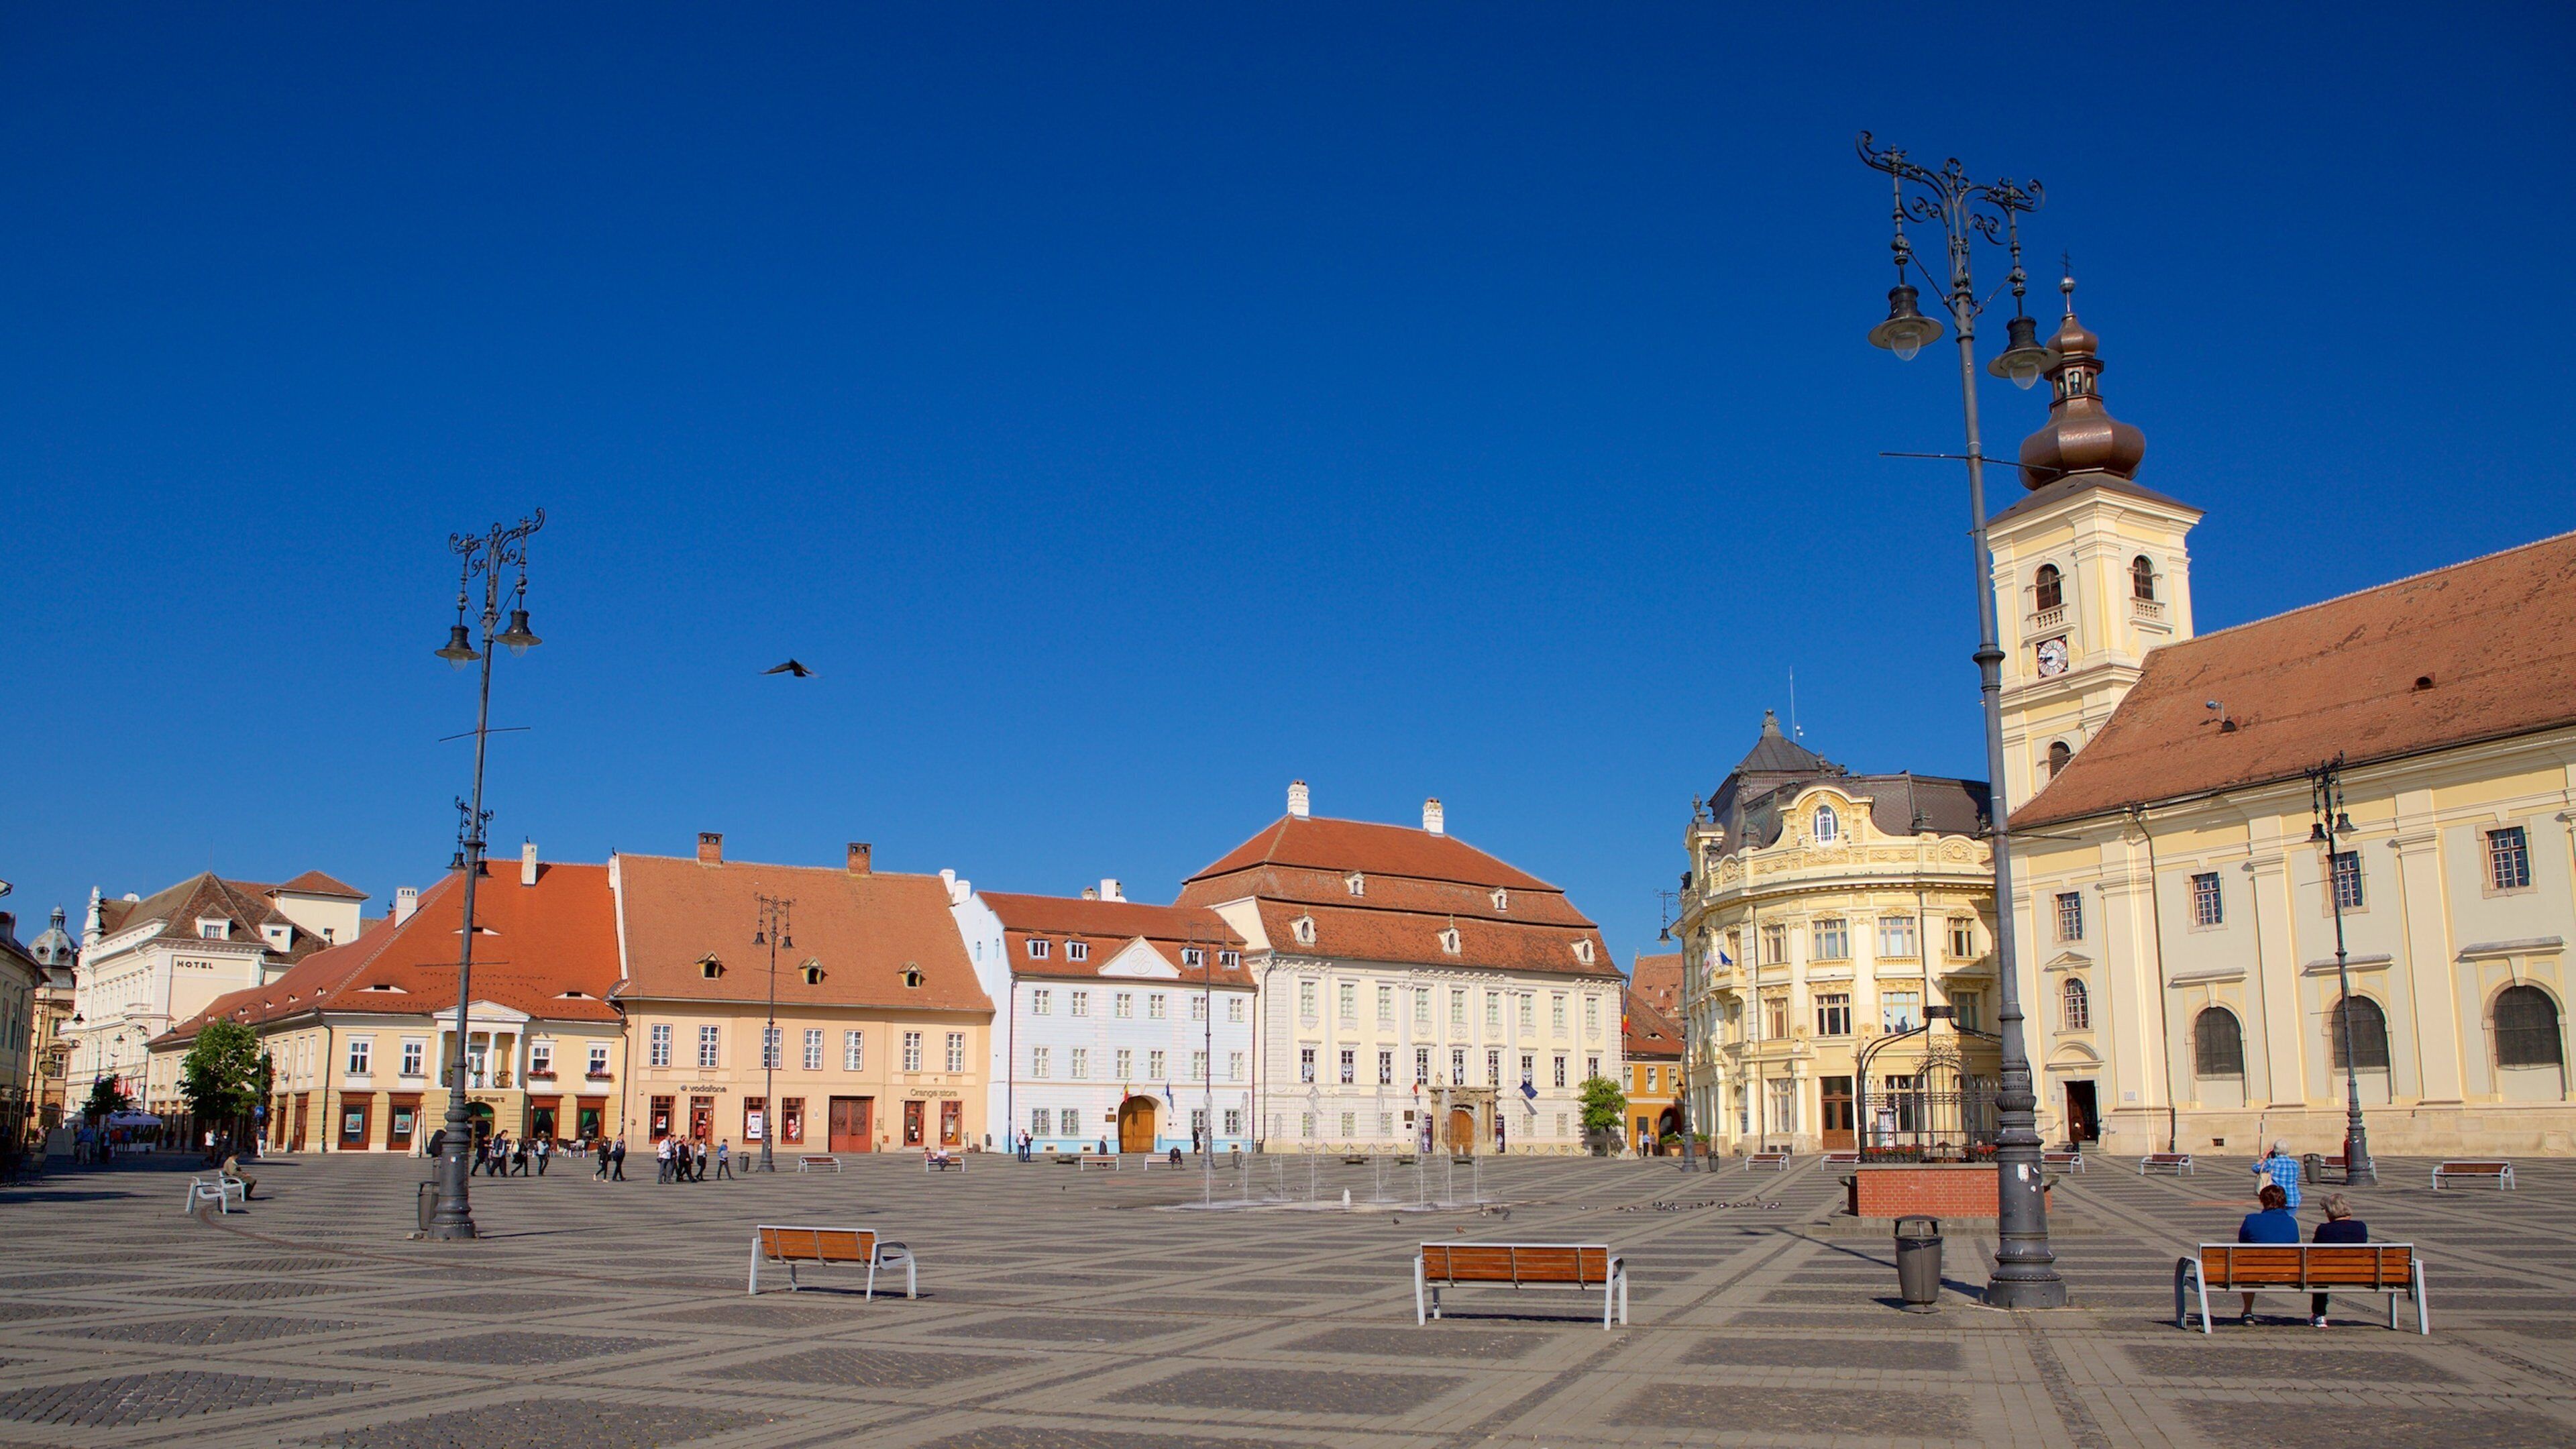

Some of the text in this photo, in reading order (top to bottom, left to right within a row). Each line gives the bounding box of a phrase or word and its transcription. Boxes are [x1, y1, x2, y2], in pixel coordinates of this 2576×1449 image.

[177, 961, 213, 969] HOTEL
[690, 1085, 727, 1093] vodafone
[910, 1089, 957, 1098] Orange store
